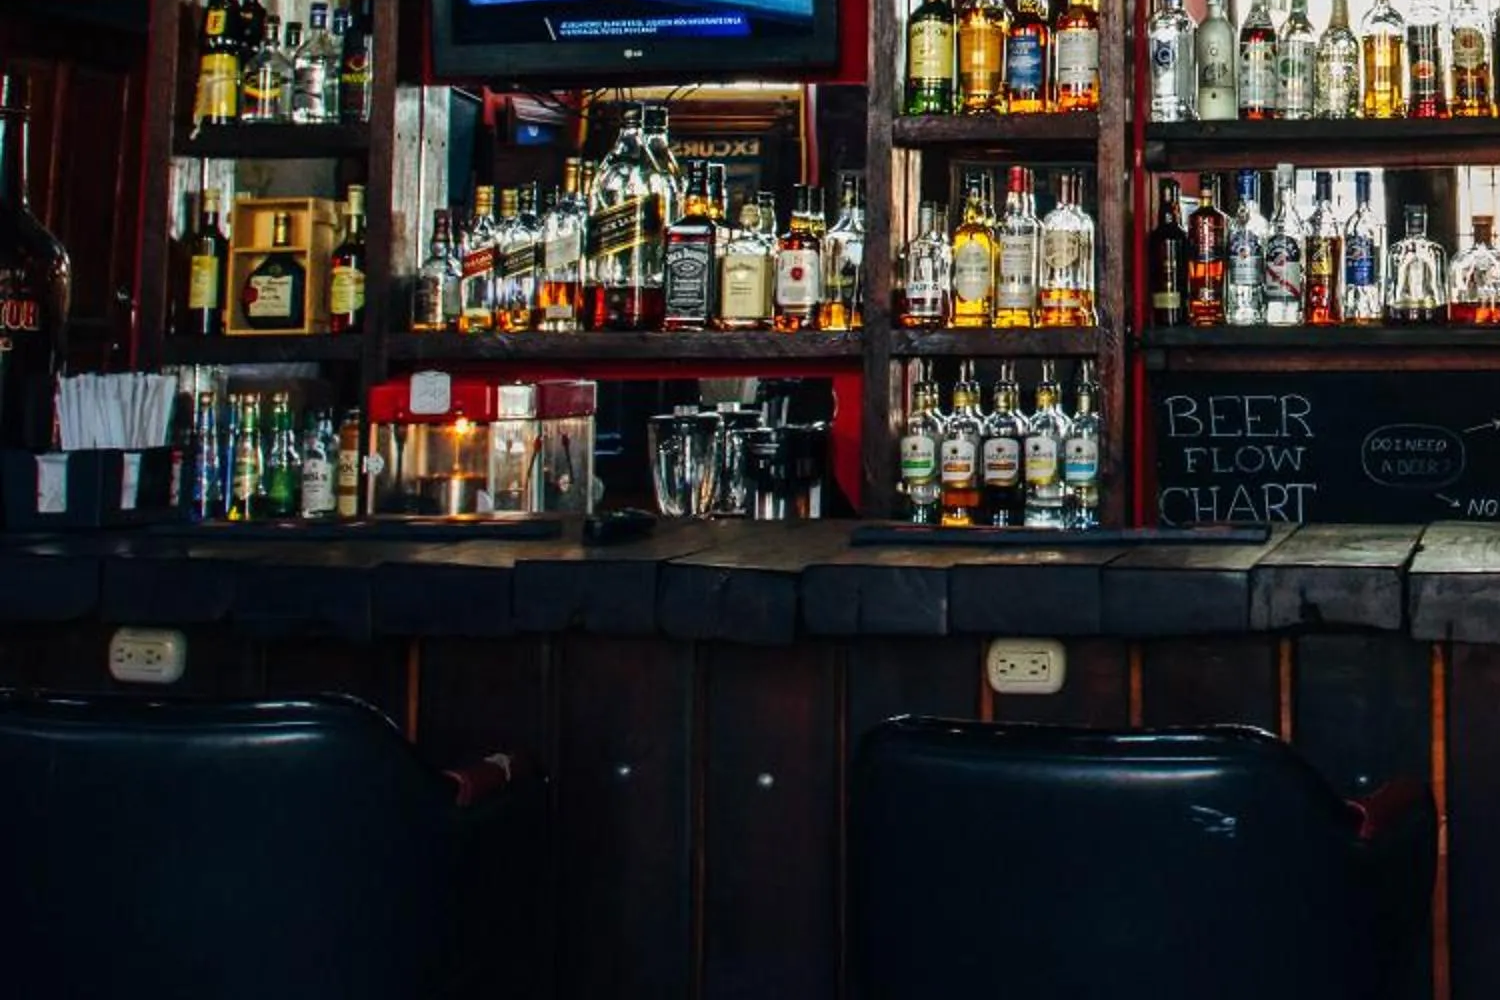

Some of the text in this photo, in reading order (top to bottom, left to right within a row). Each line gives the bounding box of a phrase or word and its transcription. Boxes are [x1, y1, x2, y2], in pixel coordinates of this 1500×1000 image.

[1164, 393, 1314, 439] BEER
[1183, 445, 1309, 474] FLOW
[1403, 438, 1447, 452] NEED
[1159, 480, 1319, 527] CHART
[1466, 498, 1500, 518] NO
